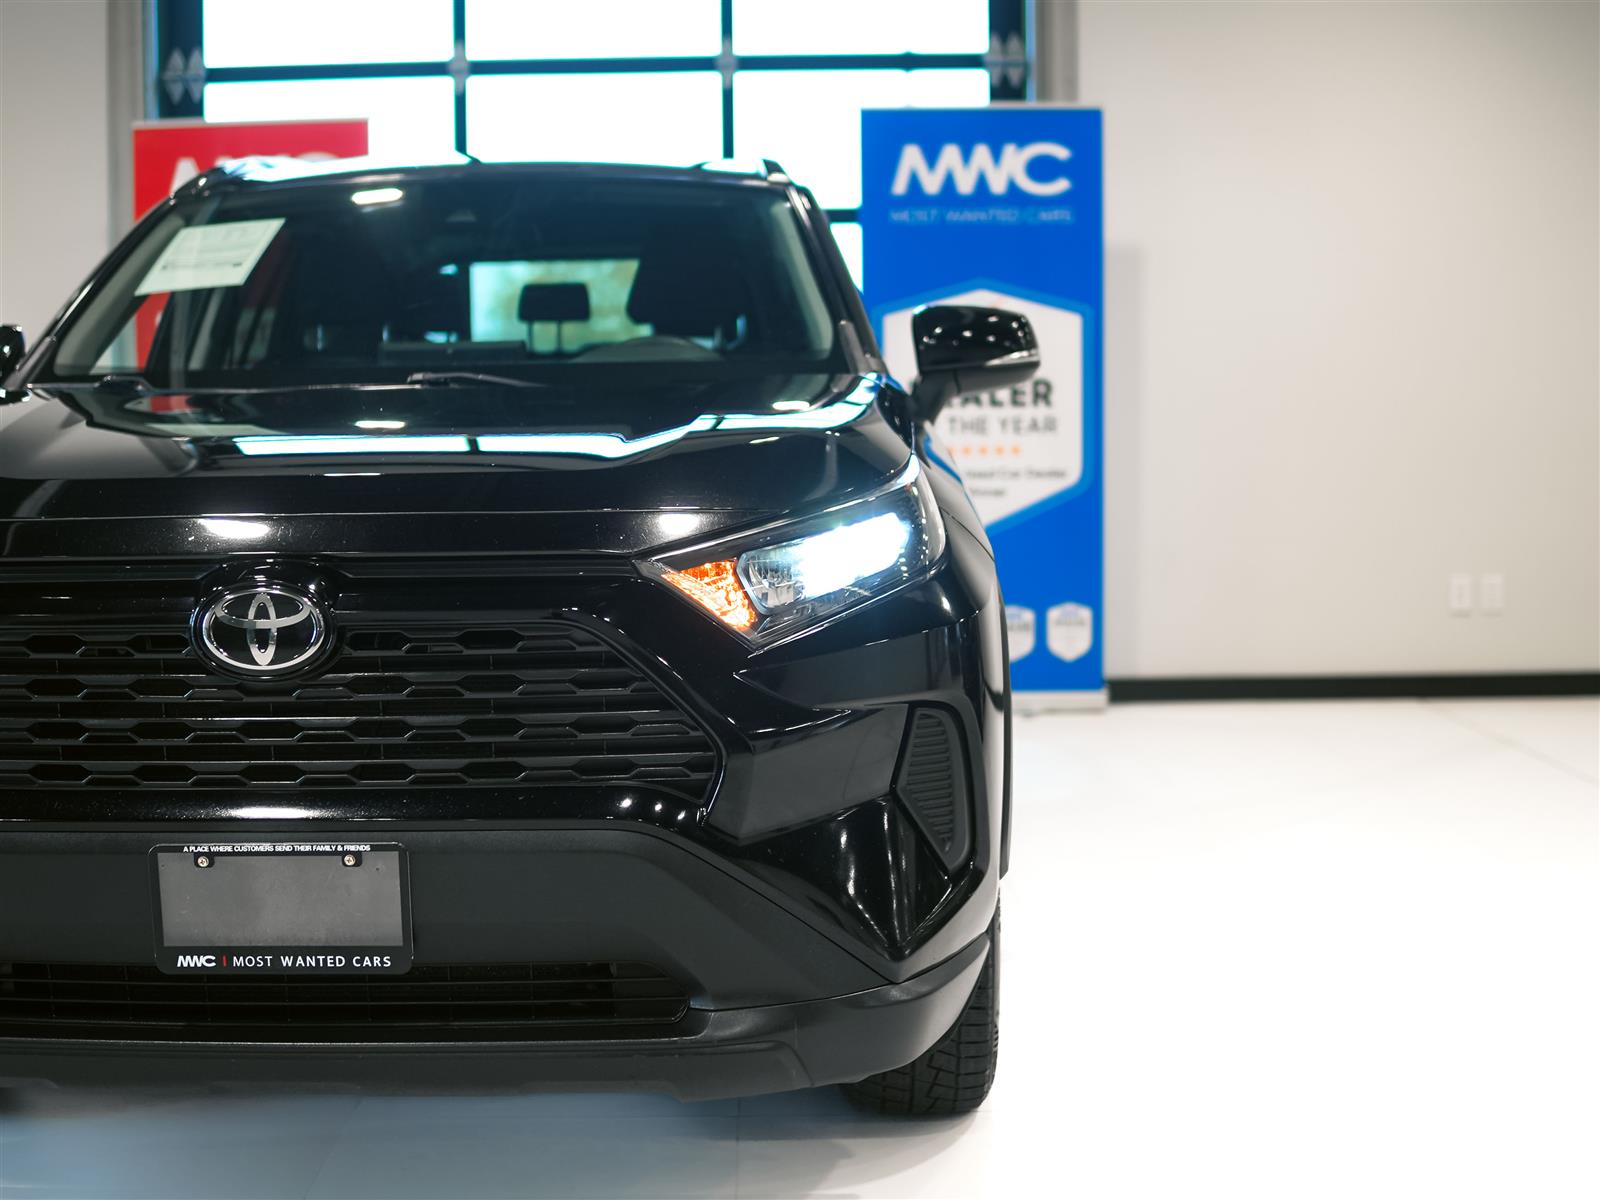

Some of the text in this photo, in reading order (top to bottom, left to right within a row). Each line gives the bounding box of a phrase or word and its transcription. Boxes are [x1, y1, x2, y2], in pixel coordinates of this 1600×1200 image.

[890, 142, 1073, 197] MWC
[945, 378, 1055, 408] ALER
[948, 415, 1058, 435] THE YEAR
[189, 845, 209, 853] PLACE
[210, 845, 233, 853] WHERE
[176, 955, 392, 968] MWC MOST WANTED CARS
